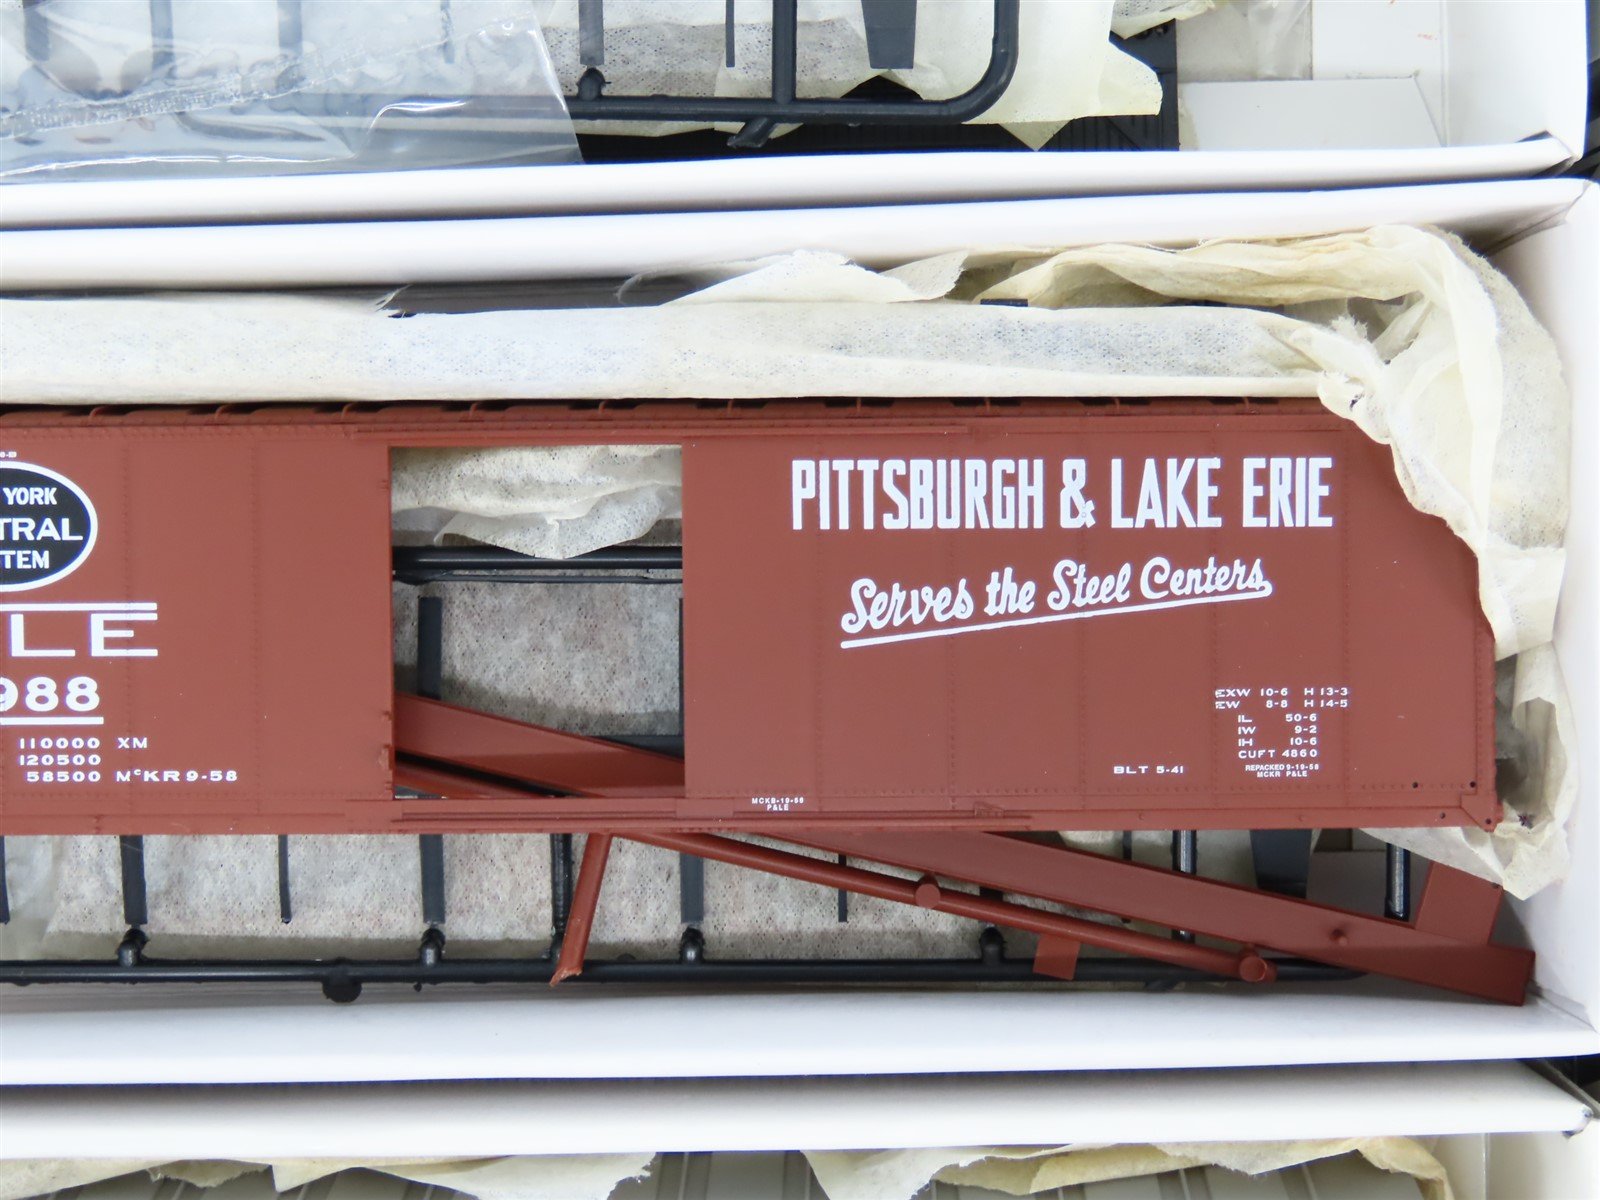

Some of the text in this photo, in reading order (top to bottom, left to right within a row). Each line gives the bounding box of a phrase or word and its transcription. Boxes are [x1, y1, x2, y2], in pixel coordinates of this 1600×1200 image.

[2, 487, 58, 505] YORK
[792, 457, 1333, 530] PITTSBURGH & LAKE ERIE
[841, 556, 1270, 634] Serves the Steel Centers
[1214, 686, 1348, 699] EXW 10-6 H 13-3
[1214, 699, 1348, 710] EW 8-8 H 14-5
[1237, 712, 1317, 723] IL 50-6
[1237, 724, 1317, 736] IW 9-2
[19, 737, 148, 749] 110000 XM
[1237, 736, 1317, 747] IH 10-6
[1281, 748, 1318, 758] 4860
[19, 754, 101, 766] 120500
[1113, 765, 1184, 774] BLT 5-41
[1245, 763, 1284, 772] REPACKED
[26, 771, 101, 783] 58500
[1285, 770, 1308, 778] P&LE
[766, 803, 789, 811] P&LE
